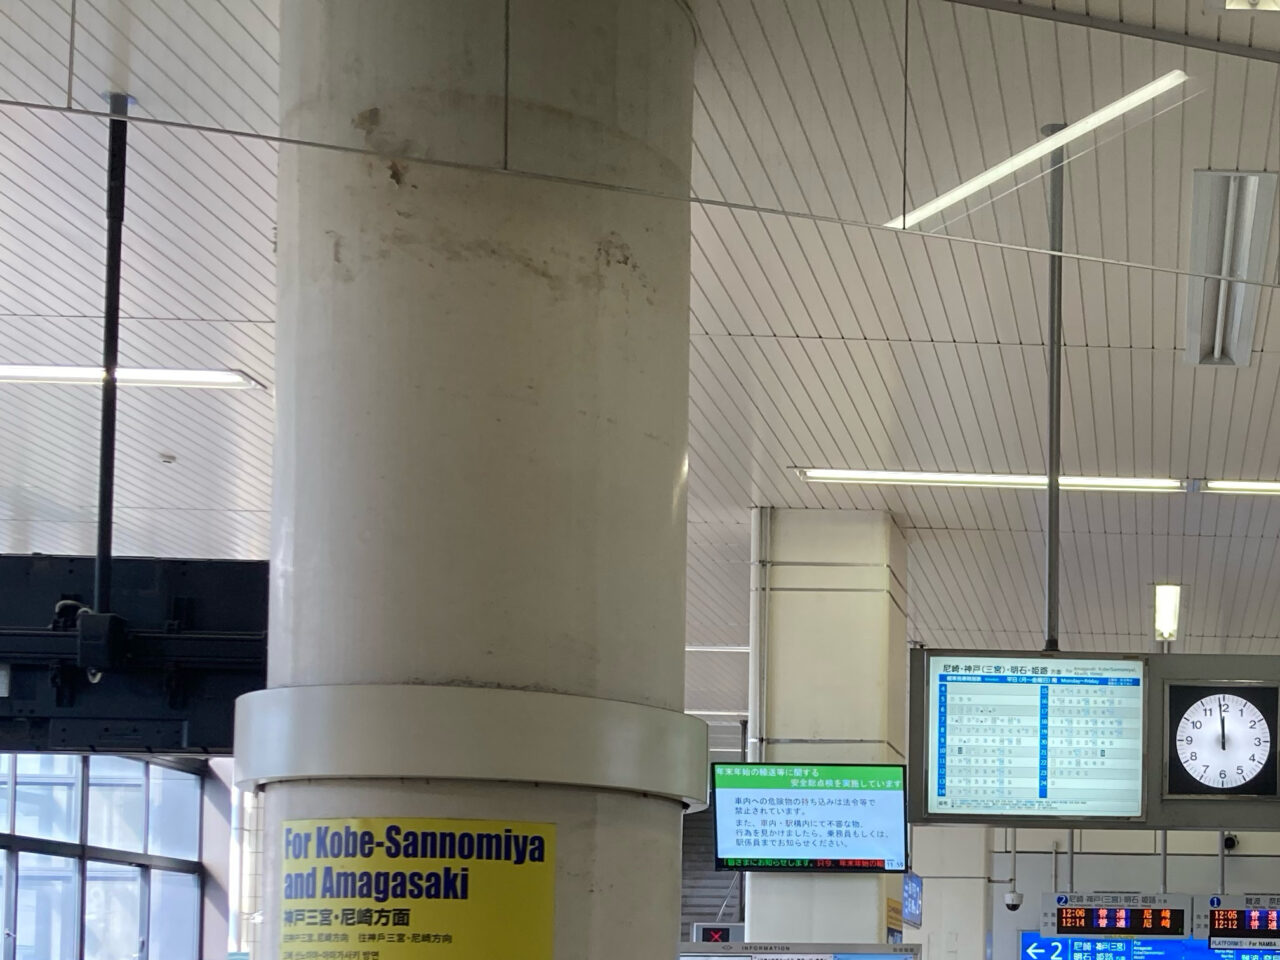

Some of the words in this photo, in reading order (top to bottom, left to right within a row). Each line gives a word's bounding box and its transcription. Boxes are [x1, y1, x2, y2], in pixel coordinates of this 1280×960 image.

[1203, 708, 1213, 717] 11
[1238, 708, 1244, 717] 1
[1191, 720, 1202, 730] 10
[1249, 720, 1257, 729] 2
[1185, 736, 1193, 745] 9
[1254, 737, 1261, 747] 3
[1190, 752, 1198, 761] 8
[1249, 753, 1256, 762] 4
[1202, 765, 1209, 774] 7
[1236, 766, 1244, 775] 5
[1219, 770, 1227, 779] 6
[285, 827, 312, 859] For
[316, 825, 545, 865] Kobe-Sannomiya
[284, 867, 316, 899] and
[321, 866, 469, 903] Amagasaki
[284, 908, 410, 927] 神戸三宮・尼崎方面
[1062, 908, 1085, 918] 12:06
[1214, 910, 1238, 920] 12:05
[1062, 918, 1085, 927] 12:14
[1214, 920, 1238, 929] 12:12
[1050, 942, 1063, 960] 2
